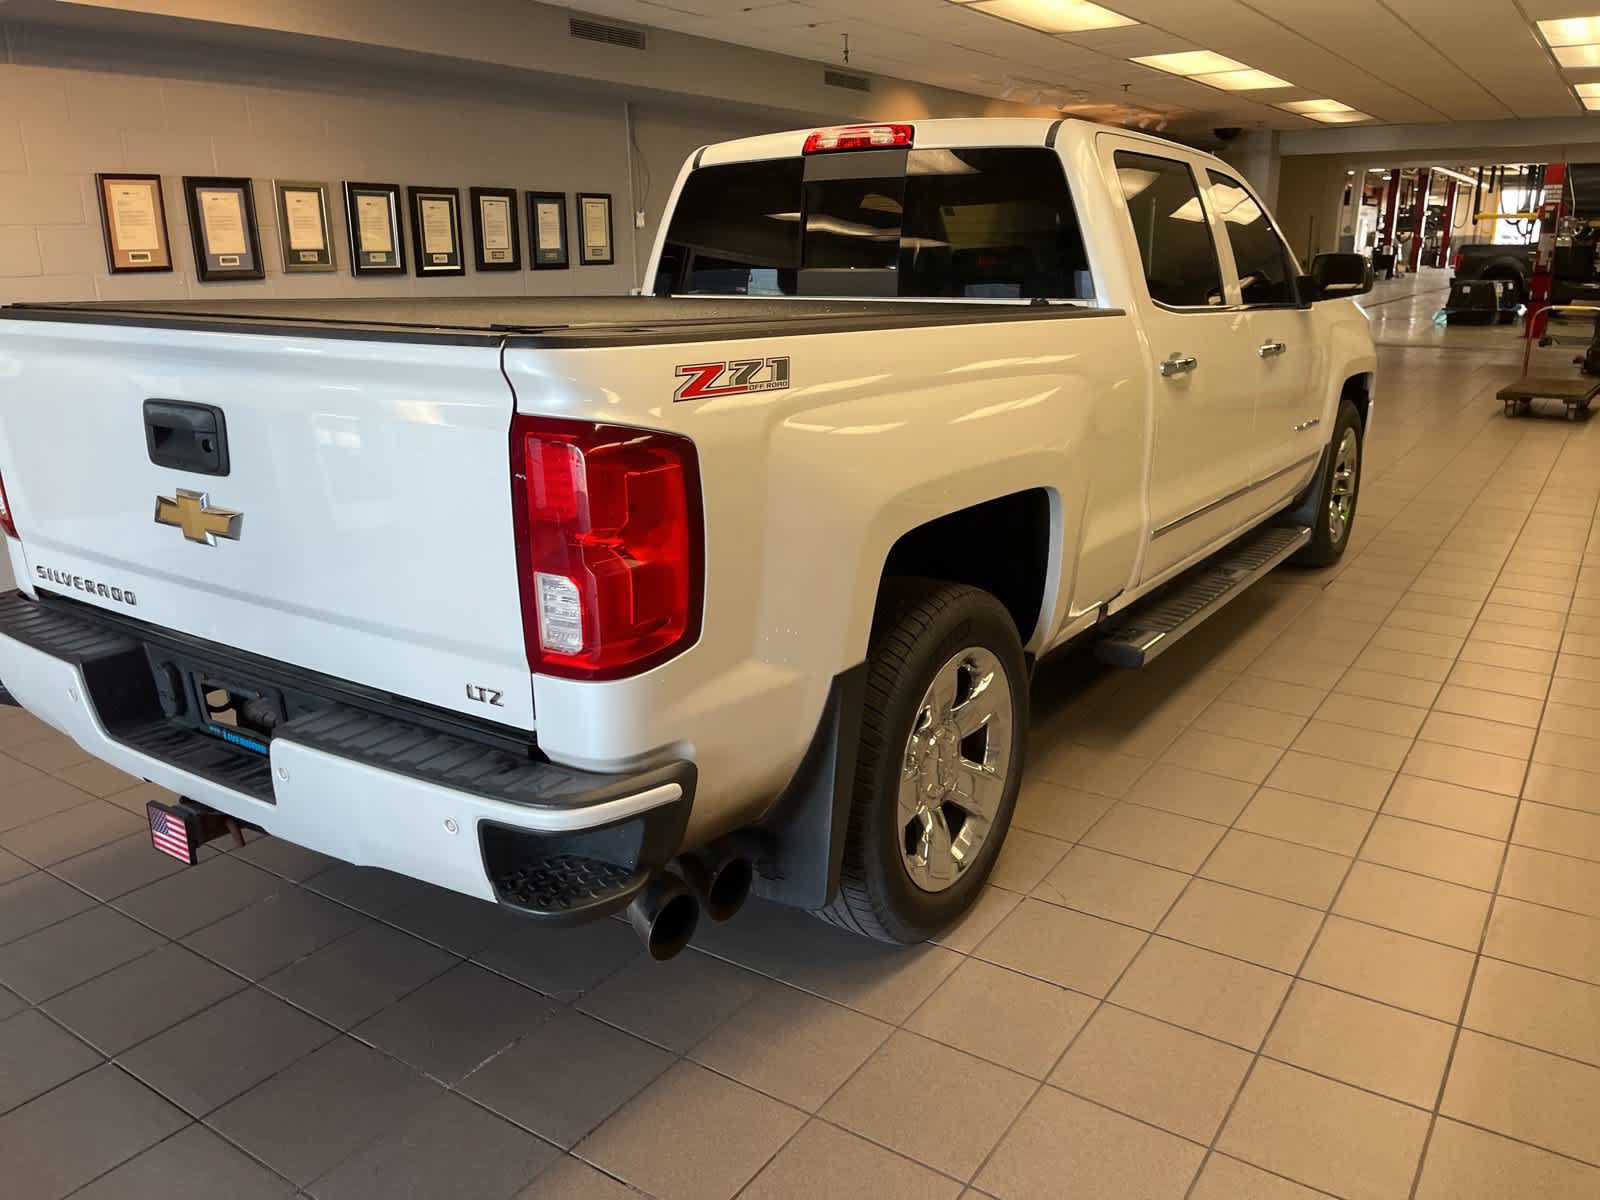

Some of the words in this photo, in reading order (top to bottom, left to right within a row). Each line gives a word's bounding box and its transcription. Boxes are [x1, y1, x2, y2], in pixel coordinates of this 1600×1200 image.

[673, 356, 790, 402] Z71
[766, 381, 788, 389] ROAD
[36, 565, 137, 606] SILVERADO
[466, 684, 504, 707] LTZ
